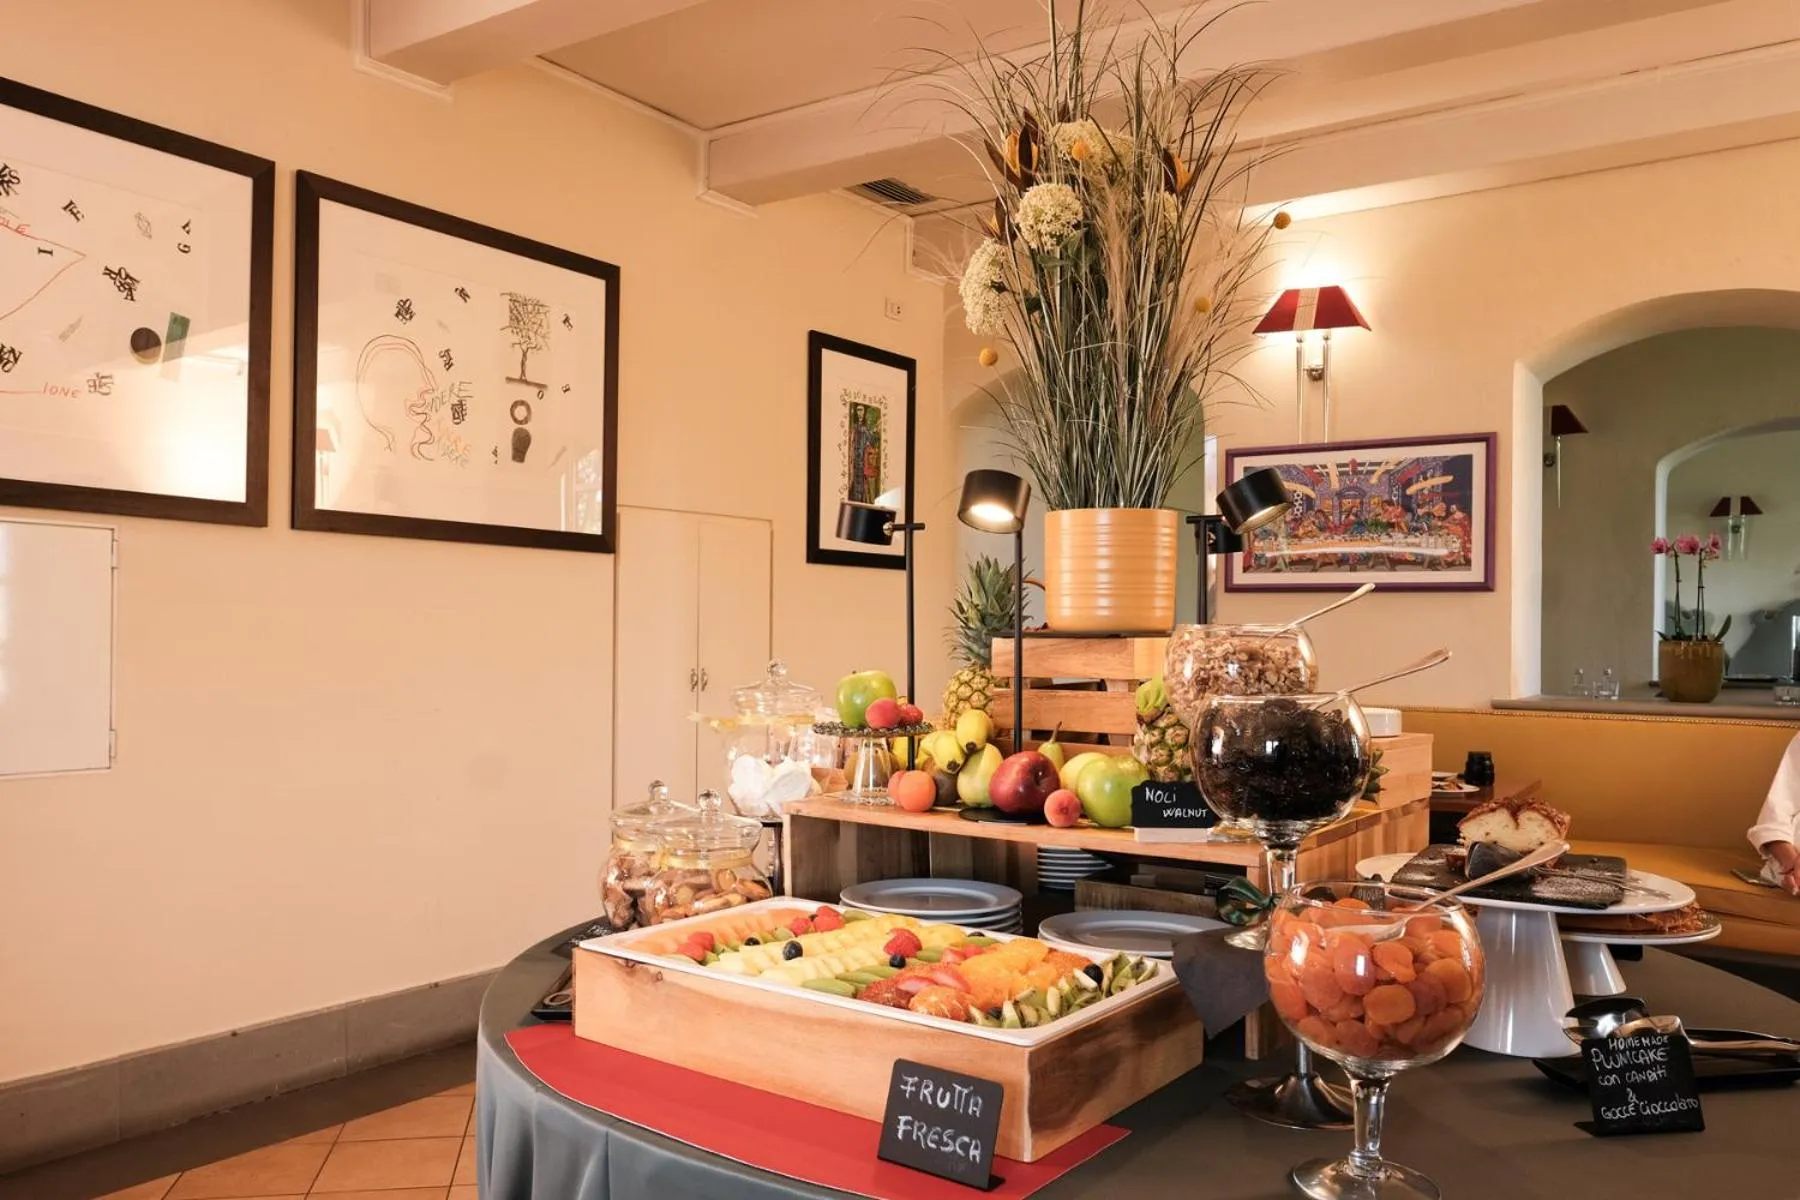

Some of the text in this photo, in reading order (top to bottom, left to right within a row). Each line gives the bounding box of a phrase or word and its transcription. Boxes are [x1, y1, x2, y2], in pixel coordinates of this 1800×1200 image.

[1163, 808, 1208, 818] WALNUT
[899, 1073, 983, 1118] FRUTTA
[897, 1115, 982, 1165] FRESCA
